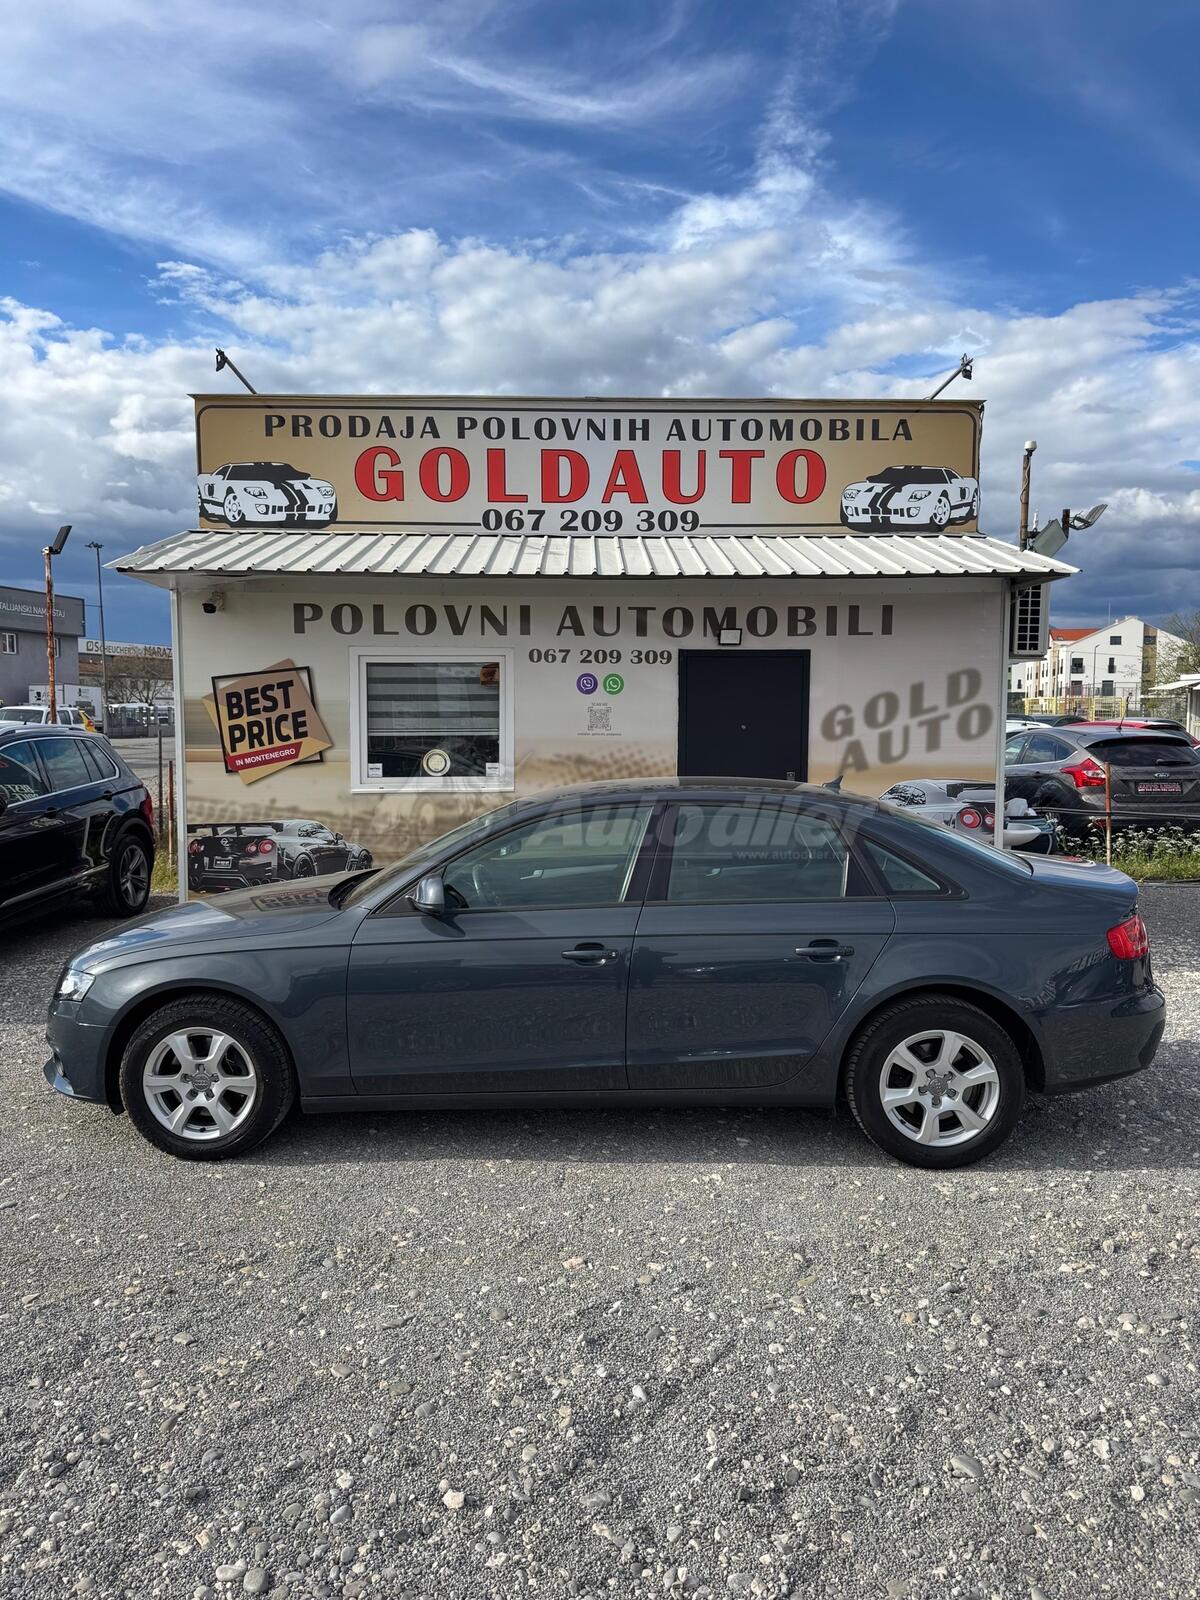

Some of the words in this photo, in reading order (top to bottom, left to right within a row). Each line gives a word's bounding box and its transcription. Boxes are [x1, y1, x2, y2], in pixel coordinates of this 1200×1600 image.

[264, 414, 441, 439] PRODAJA
[457, 416, 650, 441] POLOVNIH
[666, 418, 913, 442] AUTOMOBILA
[354, 446, 827, 505] GOLDAUTO
[481, 508, 546, 531] 067
[559, 509, 623, 532] 209
[636, 509, 701, 532] 309
[293, 602, 531, 636] POLOVNI
[556, 604, 894, 638] AUTOMOBILI
[528, 648, 571, 665] 067
[579, 648, 622, 665] 209
[630, 649, 673, 666] 309
[225, 680, 295, 721] BEST
[820, 667, 982, 742] GOLD
[228, 710, 309, 753] PRICE
[838, 702, 993, 776] AUTO
[235, 758, 244, 767] IN
[245, 748, 296, 765] MONTENEGRO
